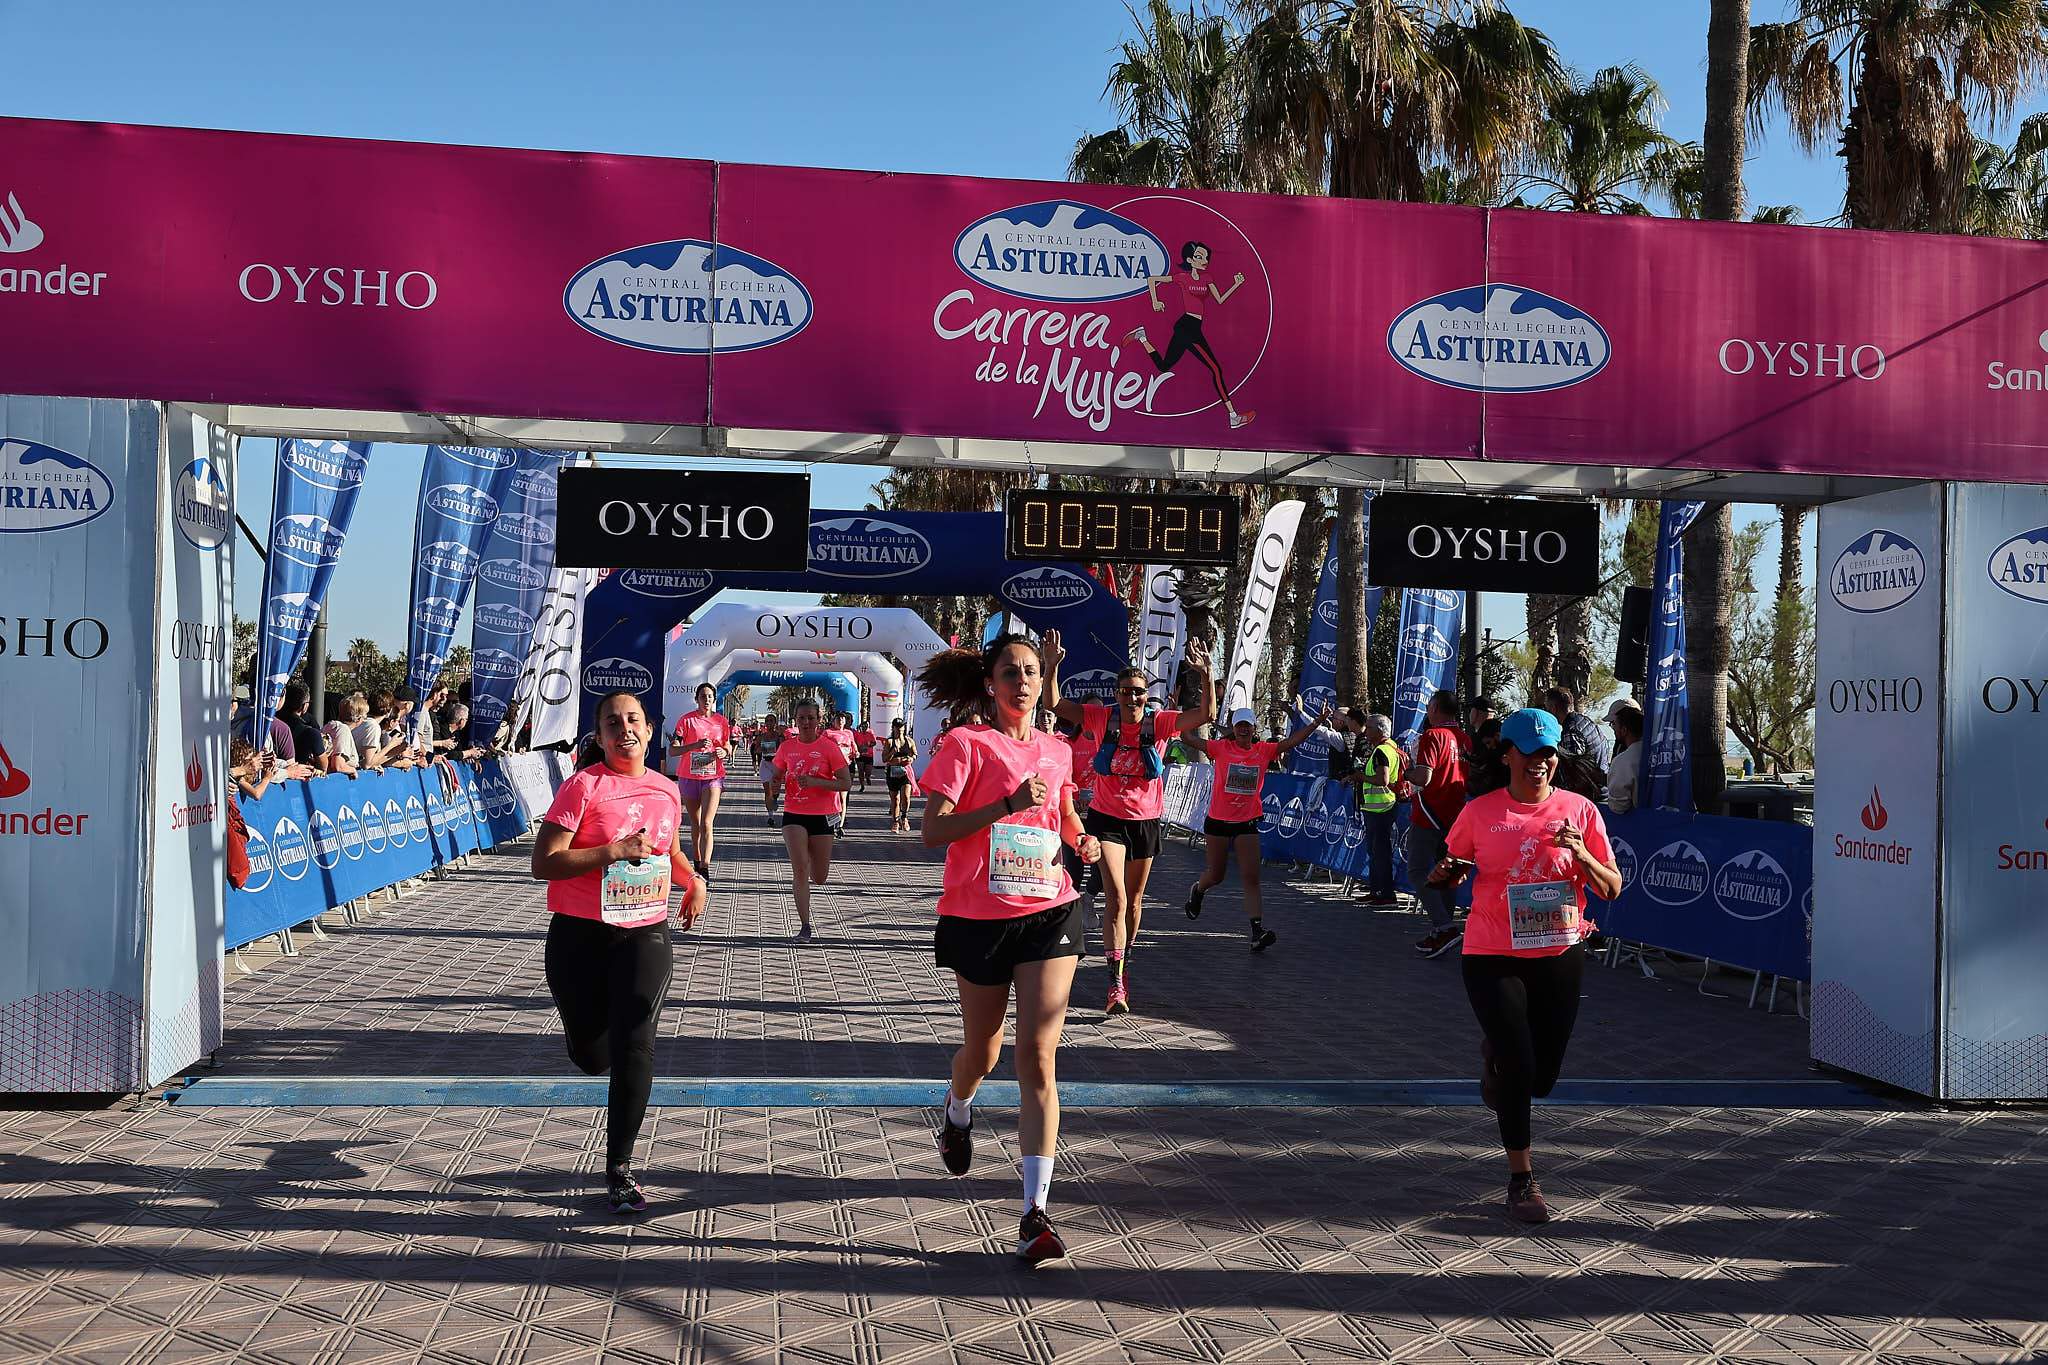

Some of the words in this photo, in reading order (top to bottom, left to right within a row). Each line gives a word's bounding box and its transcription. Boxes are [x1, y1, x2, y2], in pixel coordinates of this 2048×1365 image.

[970, 233, 1151, 280] ASTURIANA
[1005, 232, 1073, 245] CENTRAL
[1080, 237, 1148, 250] LECHERA
[238, 263, 438, 310] OYSHO
[622, 276, 700, 290] CENTRAL
[582, 277, 794, 327] ASTURIANA
[933, 289, 1111, 349] Carrera
[1439, 319, 1510, 332] CENTRAL
[1516, 322, 1587, 335] LECHERA
[1404, 319, 1594, 367] ASTURIANA
[1718, 338, 1887, 381] OYSHO
[975, 346, 1009, 385] de
[1015, 347, 1039, 386] la
[1032, 346, 1176, 432] Mujer
[25, 473, 92, 484] LECHERA
[285, 443, 363, 483] ASTURIANA
[431, 491, 495, 519] ASTURIANA
[598, 500, 774, 541] OYSHO
[818, 533, 865, 543] CENTRAL
[869, 535, 917, 544] LECHERA
[1023, 501, 1223, 552] 00:37:24
[1406, 524, 1567, 564] OYSHO
[1849, 557, 1881, 571] CENTRAL
[1881, 553, 1915, 568] LECHERA
[625, 570, 706, 588] ASTURIANA
[1009, 582, 1088, 599] ASTURIANA
[1835, 563, 1919, 596] ASTURIANA
[0, 617, 110, 660] HO
[171, 619, 227, 664] OYSHO
[756, 613, 873, 640] OYSHO
[685, 638, 721, 648] OYSHO
[905, 642, 940, 651] OYSHO
[585, 671, 648, 688] ASTURIANA
[1829, 676, 1924, 714] OYSHO
[171, 801, 218, 831] Santander
[1015, 856, 1043, 870] 016
[1835, 833, 1913, 866] Santander
[627, 885, 651, 896] 016
[1645, 862, 1702, 892] ASTURIANA
[1717, 871, 1782, 907] ASTURIANA
